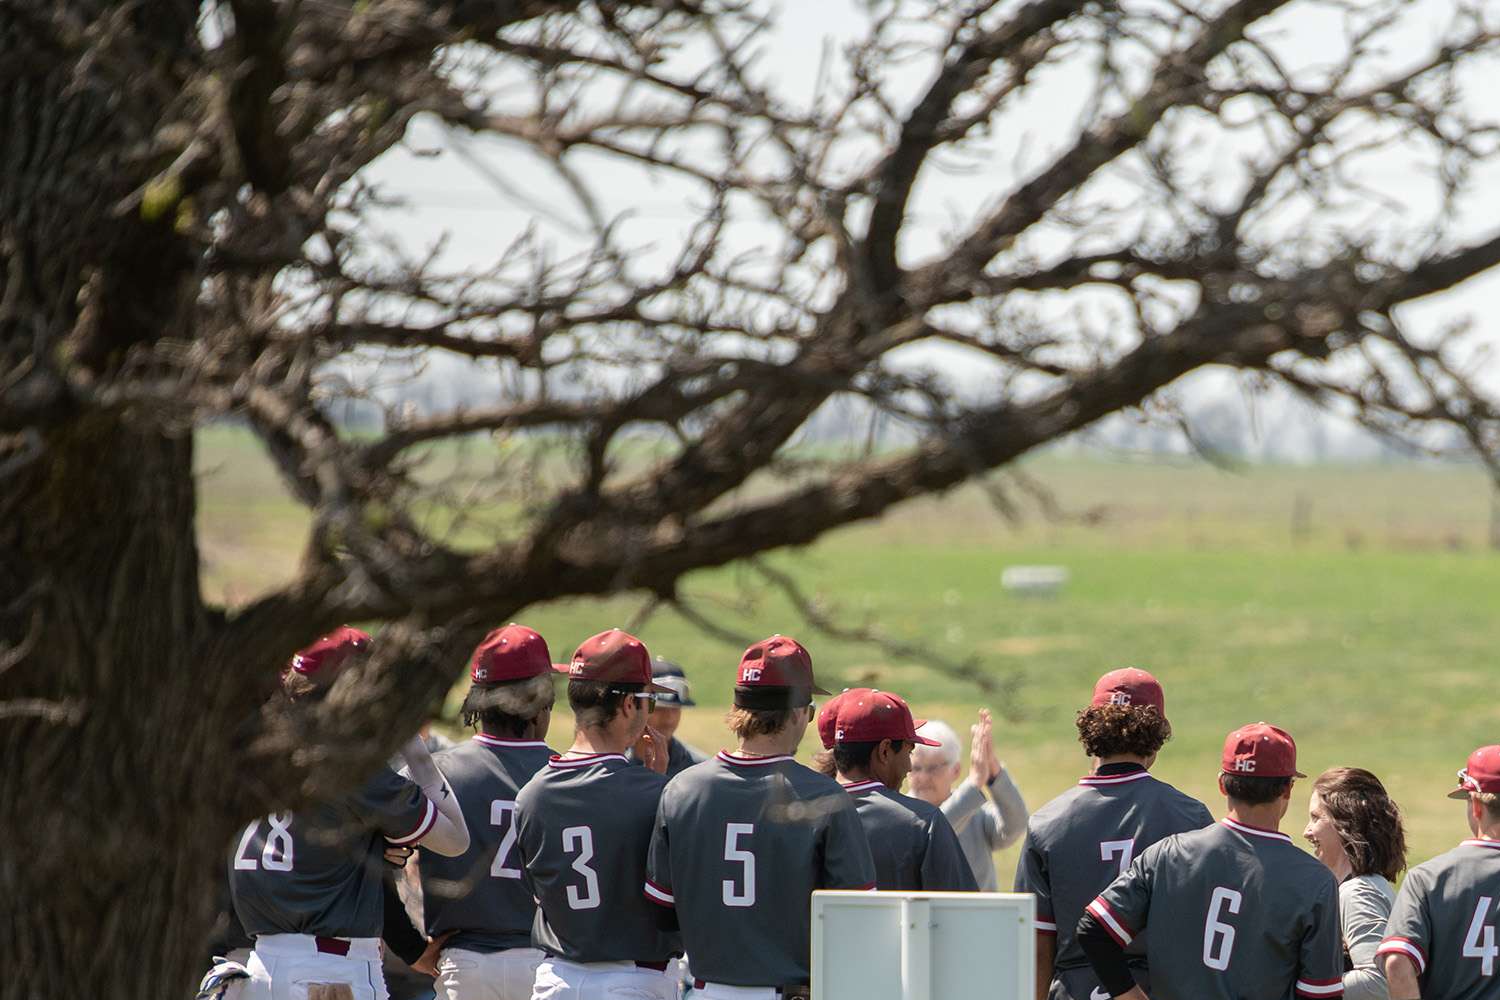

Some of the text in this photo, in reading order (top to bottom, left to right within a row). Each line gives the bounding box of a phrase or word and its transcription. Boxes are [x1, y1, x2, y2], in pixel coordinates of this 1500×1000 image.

[475, 668, 488, 679] HC
[569, 660, 585, 675] HC
[742, 668, 762, 682] HC
[1110, 691, 1132, 706] HC
[1235, 759, 1257, 773] HC
[233, 808, 294, 872] 28
[562, 825, 601, 910] 3
[722, 822, 756, 907] 5
[1100, 837, 1135, 878] 7
[1203, 886, 1242, 972] 6
